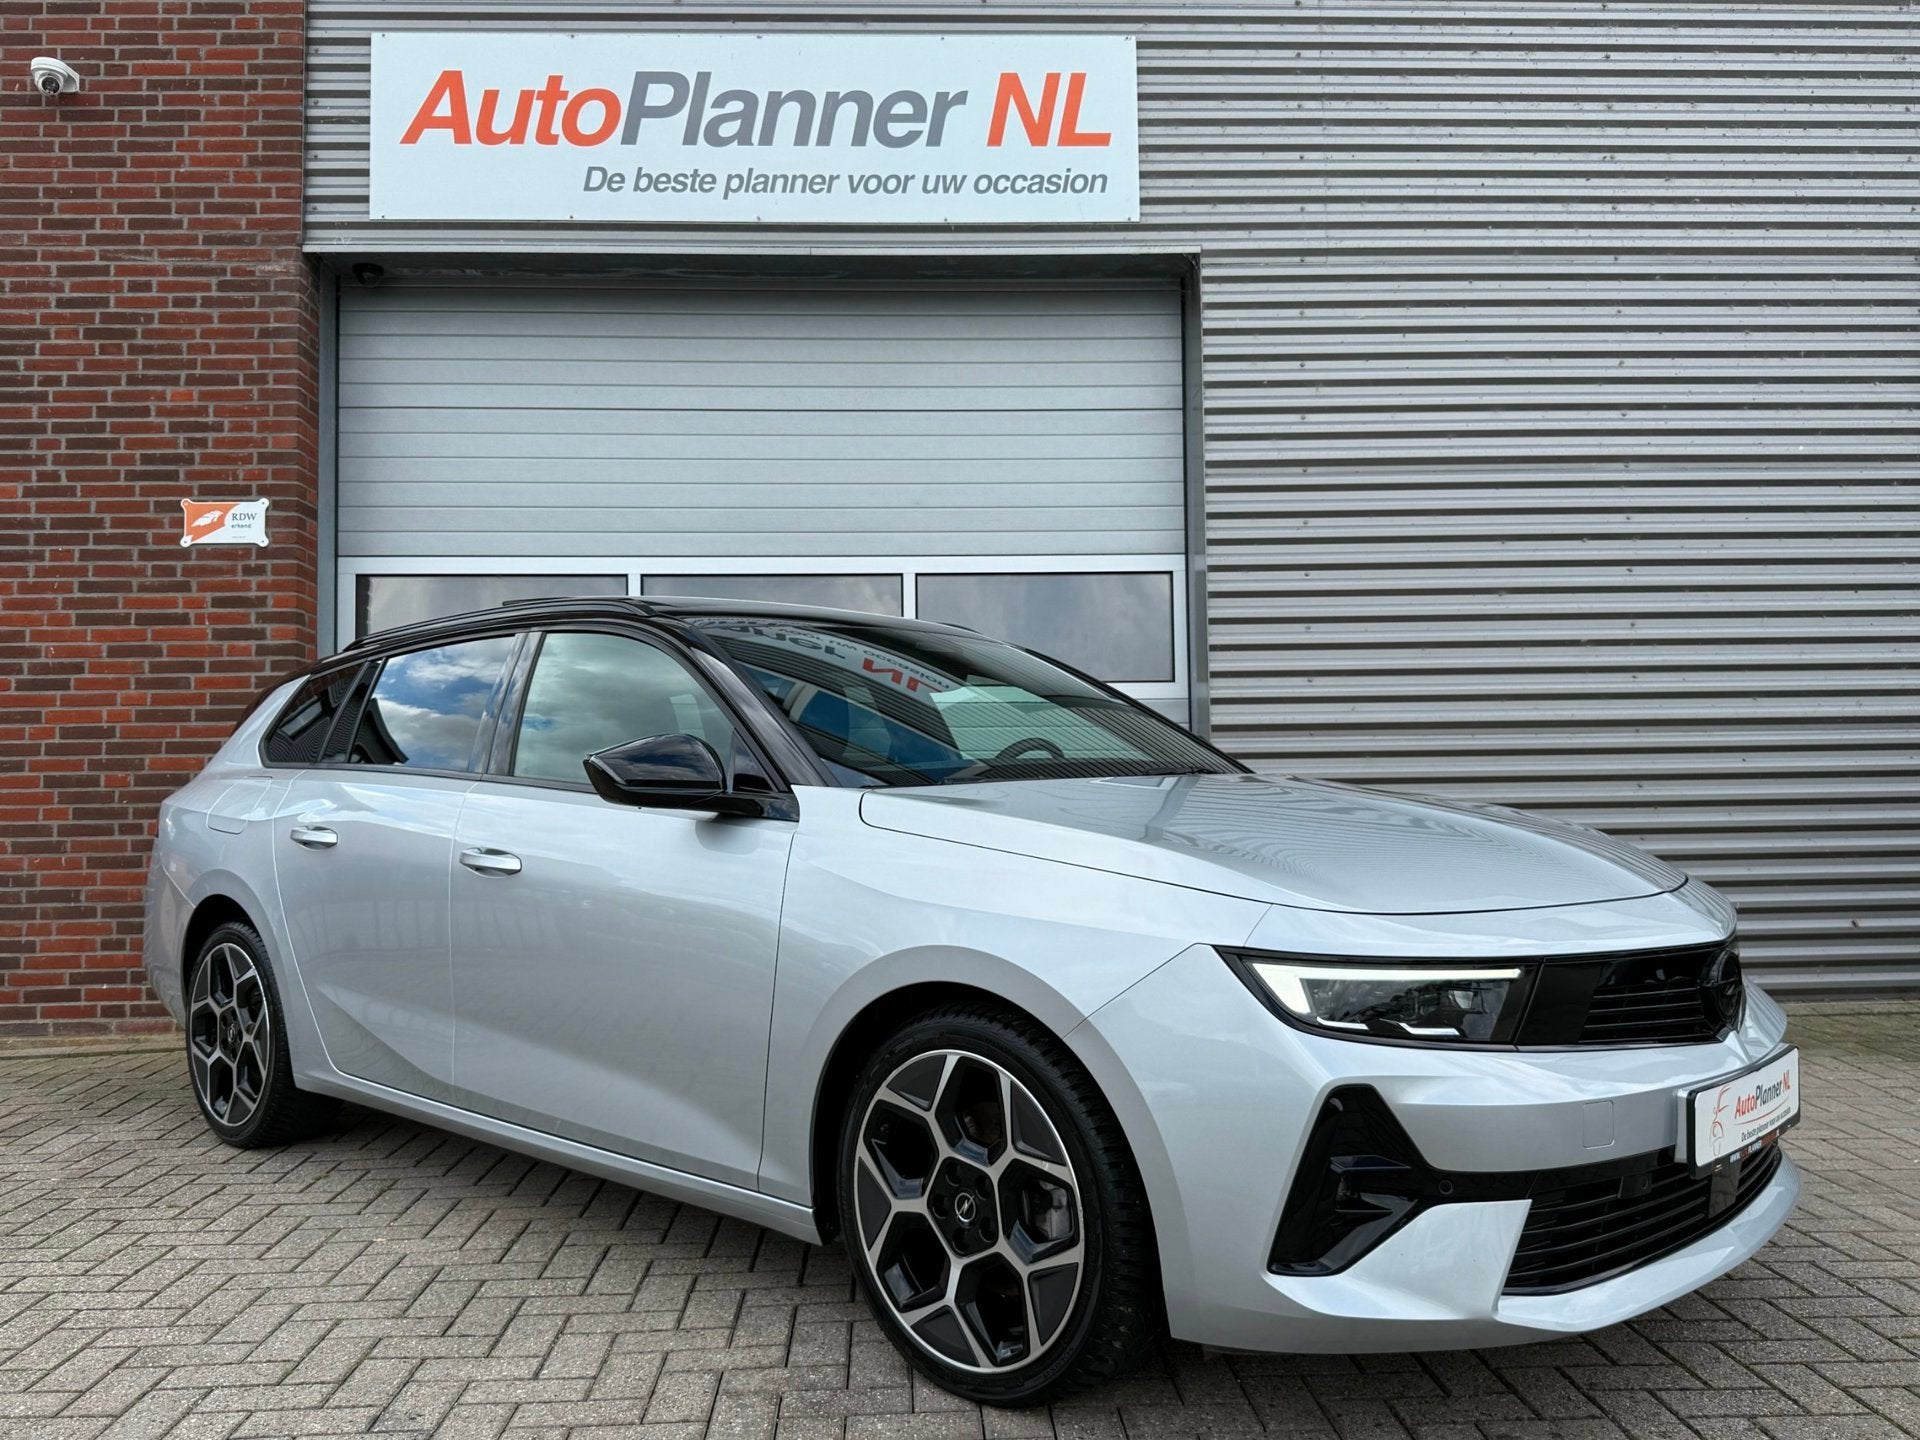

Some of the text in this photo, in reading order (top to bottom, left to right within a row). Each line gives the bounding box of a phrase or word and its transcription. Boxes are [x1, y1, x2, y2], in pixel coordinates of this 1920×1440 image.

[399, 70, 1111, 148] AutoPlanner NL
[583, 166, 1108, 199] De beste planner voor uw occasion
[231, 512, 257, 521] RDW
[1734, 1080, 1782, 1119] AutoPlanner
